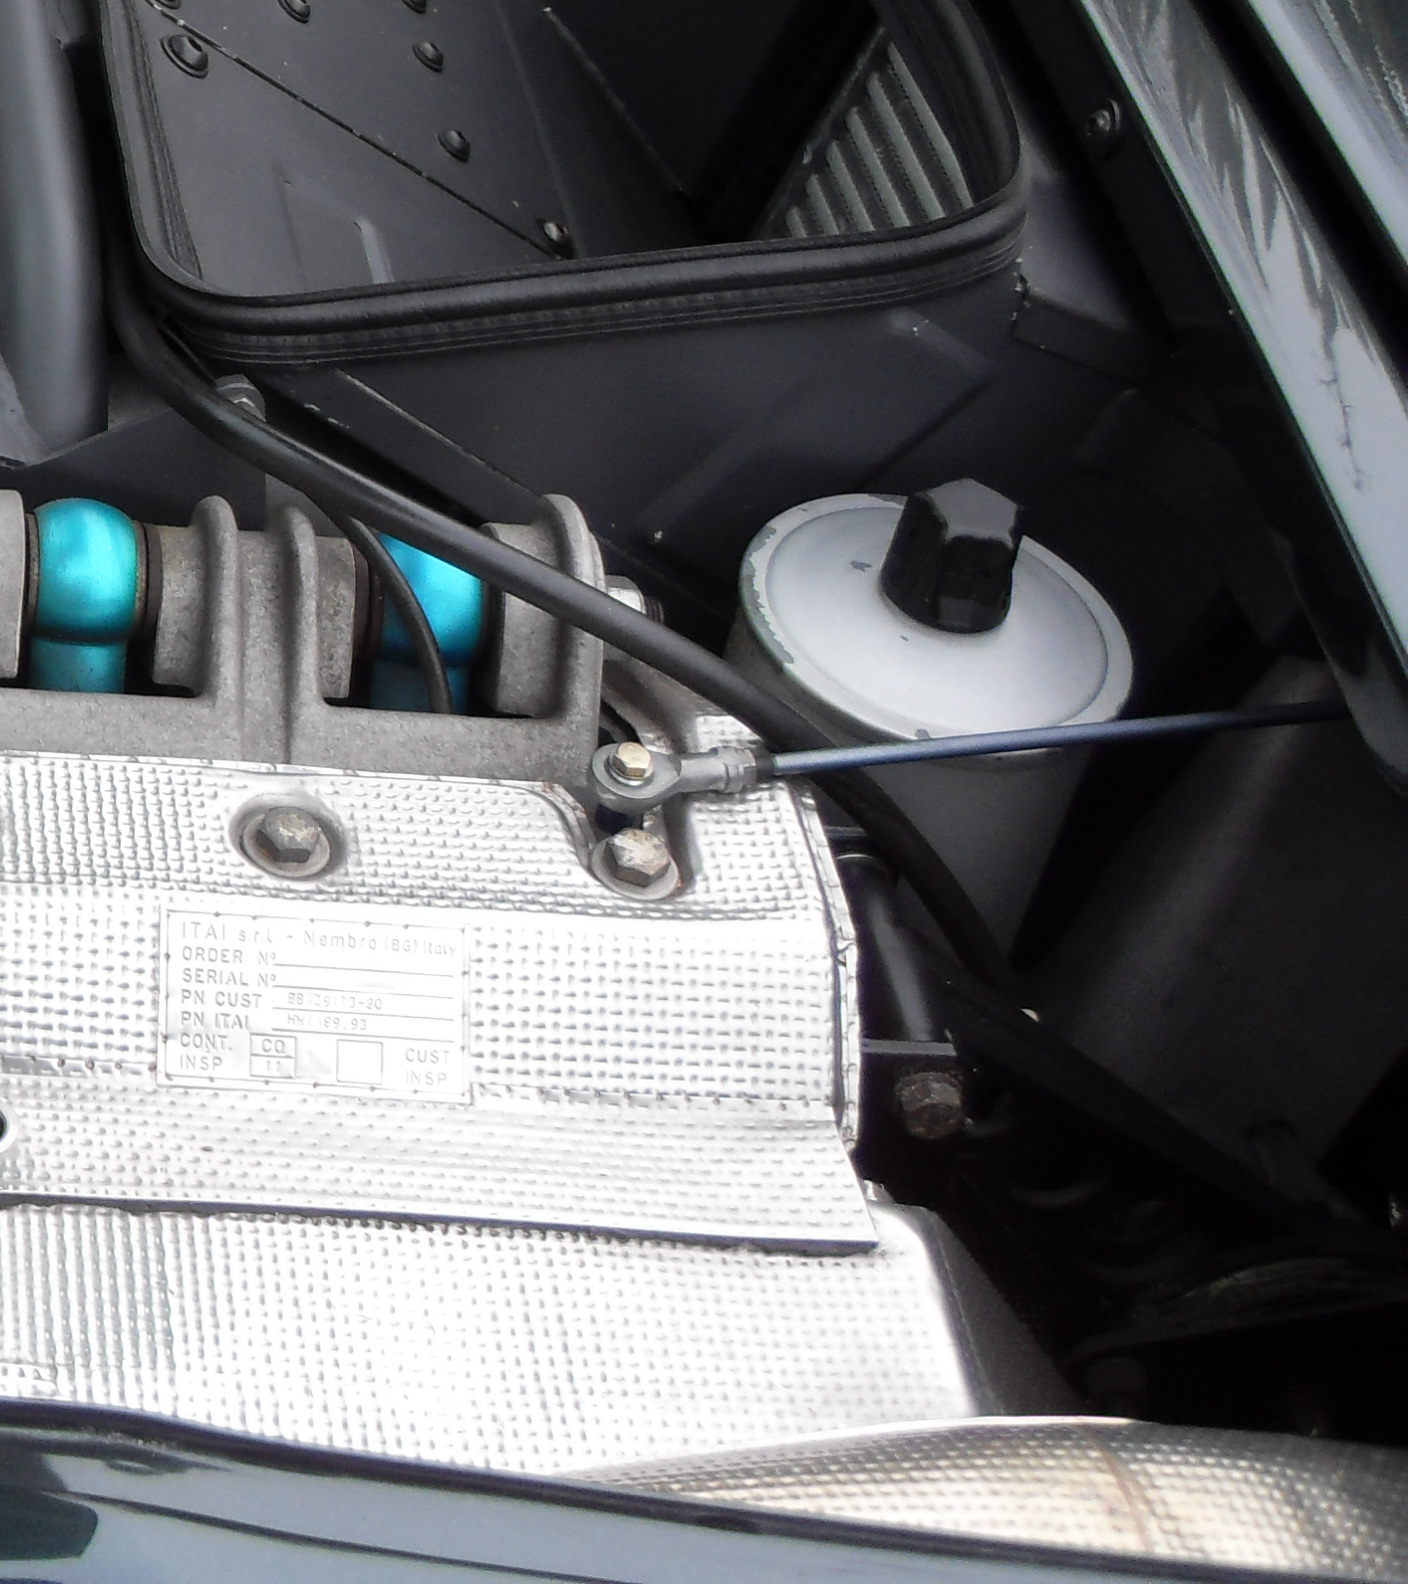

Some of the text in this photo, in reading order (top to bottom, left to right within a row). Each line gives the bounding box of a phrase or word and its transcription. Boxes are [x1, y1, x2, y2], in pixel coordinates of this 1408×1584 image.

[182, 945, 244, 964] ORDER
[423, 935, 456, 959] Italy
[182, 967, 249, 987] SERIAL
[180, 989, 205, 1005] PN
[214, 990, 263, 1009] CUST
[180, 1010, 205, 1028] PN
[179, 1033, 233, 1053] CONT.
[180, 1054, 224, 1071] INSP
[405, 1048, 451, 1064] CUST
[405, 1070, 448, 1086] INSP
